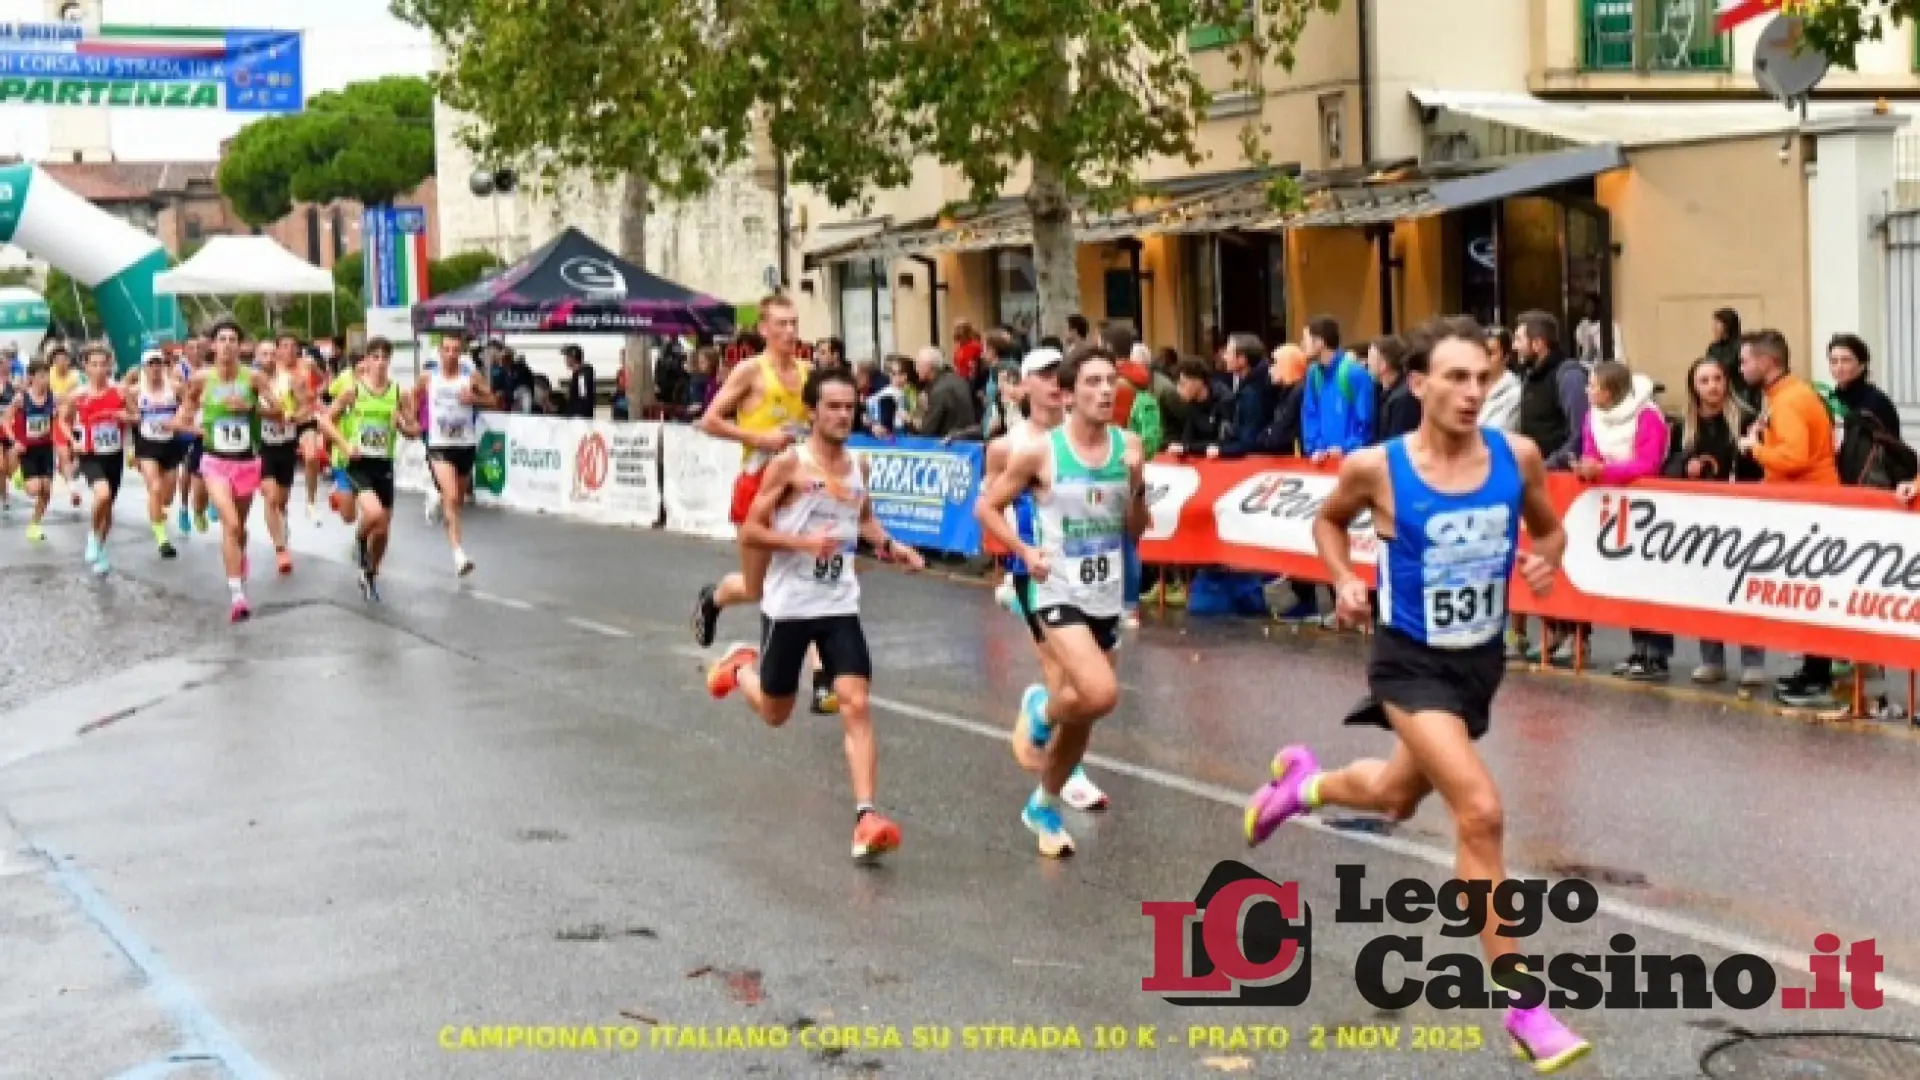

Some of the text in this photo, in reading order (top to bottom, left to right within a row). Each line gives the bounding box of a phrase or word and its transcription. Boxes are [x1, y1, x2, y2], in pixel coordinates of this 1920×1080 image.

[20, 55, 80, 73] CORSA
[0, 78, 218, 107] PARTENZA
[1080, 553, 1110, 584] 69
[1433, 583, 1496, 628] 531
[1746, 577, 1823, 611] PRATO
